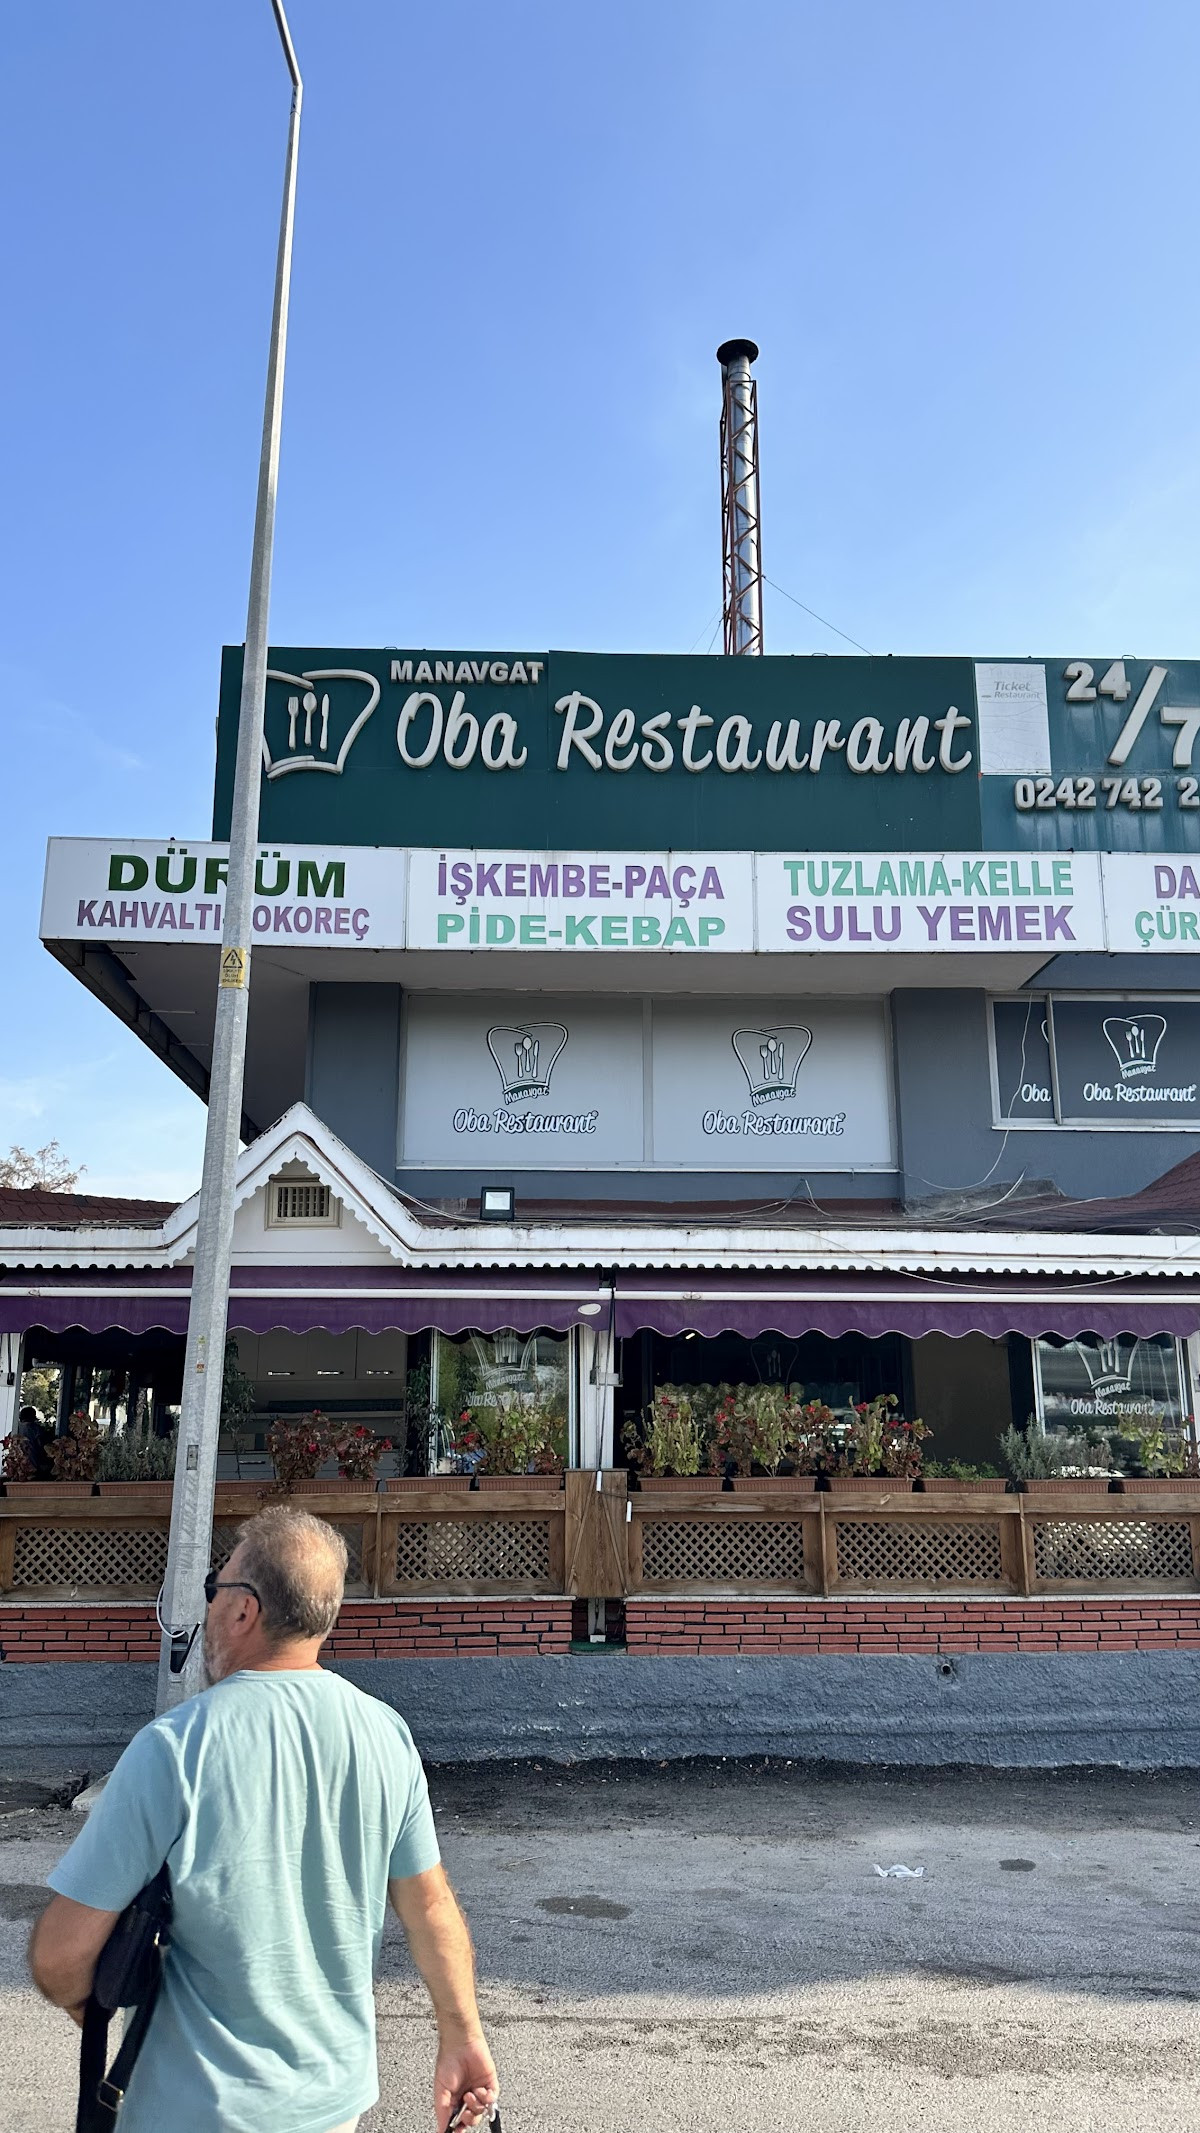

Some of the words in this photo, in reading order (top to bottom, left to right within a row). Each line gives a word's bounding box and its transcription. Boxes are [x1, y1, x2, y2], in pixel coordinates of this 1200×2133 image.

[390, 660, 544, 685] MANAVGAT
[994, 681, 1030, 691] Ticket
[994, 691, 1040, 699] Restaurant
[397, 691, 527, 770] Oba
[555, 690, 972, 774] Restaurant
[1014, 777, 1096, 811] 0242
[1101, 777, 1163, 811] 742
[108, 848, 345, 899] DÜRÜM
[437, 854, 725, 908] İŞKEMBE-PAÇA
[784, 860, 1074, 897] TUZLAMA-KELLE
[77, 900, 370, 940] KAHVALTIOKOREÇ
[437, 906, 725, 947] PİDE-KEBAP
[786, 905, 900, 941] SULU
[917, 905, 1077, 941] YEMEK
[1135, 905, 1200, 947] ÇÜR
[505, 1086, 550, 1105] Manavgat
[752, 1088, 796, 1107] Manavgat
[1021, 1083, 1051, 1102] Oba
[1083, 1083, 1113, 1101] Oba
[1115, 1083, 1196, 1102] Restaurant
[453, 1108, 492, 1133] Oba
[493, 1108, 597, 1134] Restaurant
[703, 1110, 741, 1135] Oba
[741, 1110, 845, 1136] Restaurant
[1094, 1382, 1131, 1399] Manavgat
[1070, 1399, 1093, 1414] Oba
